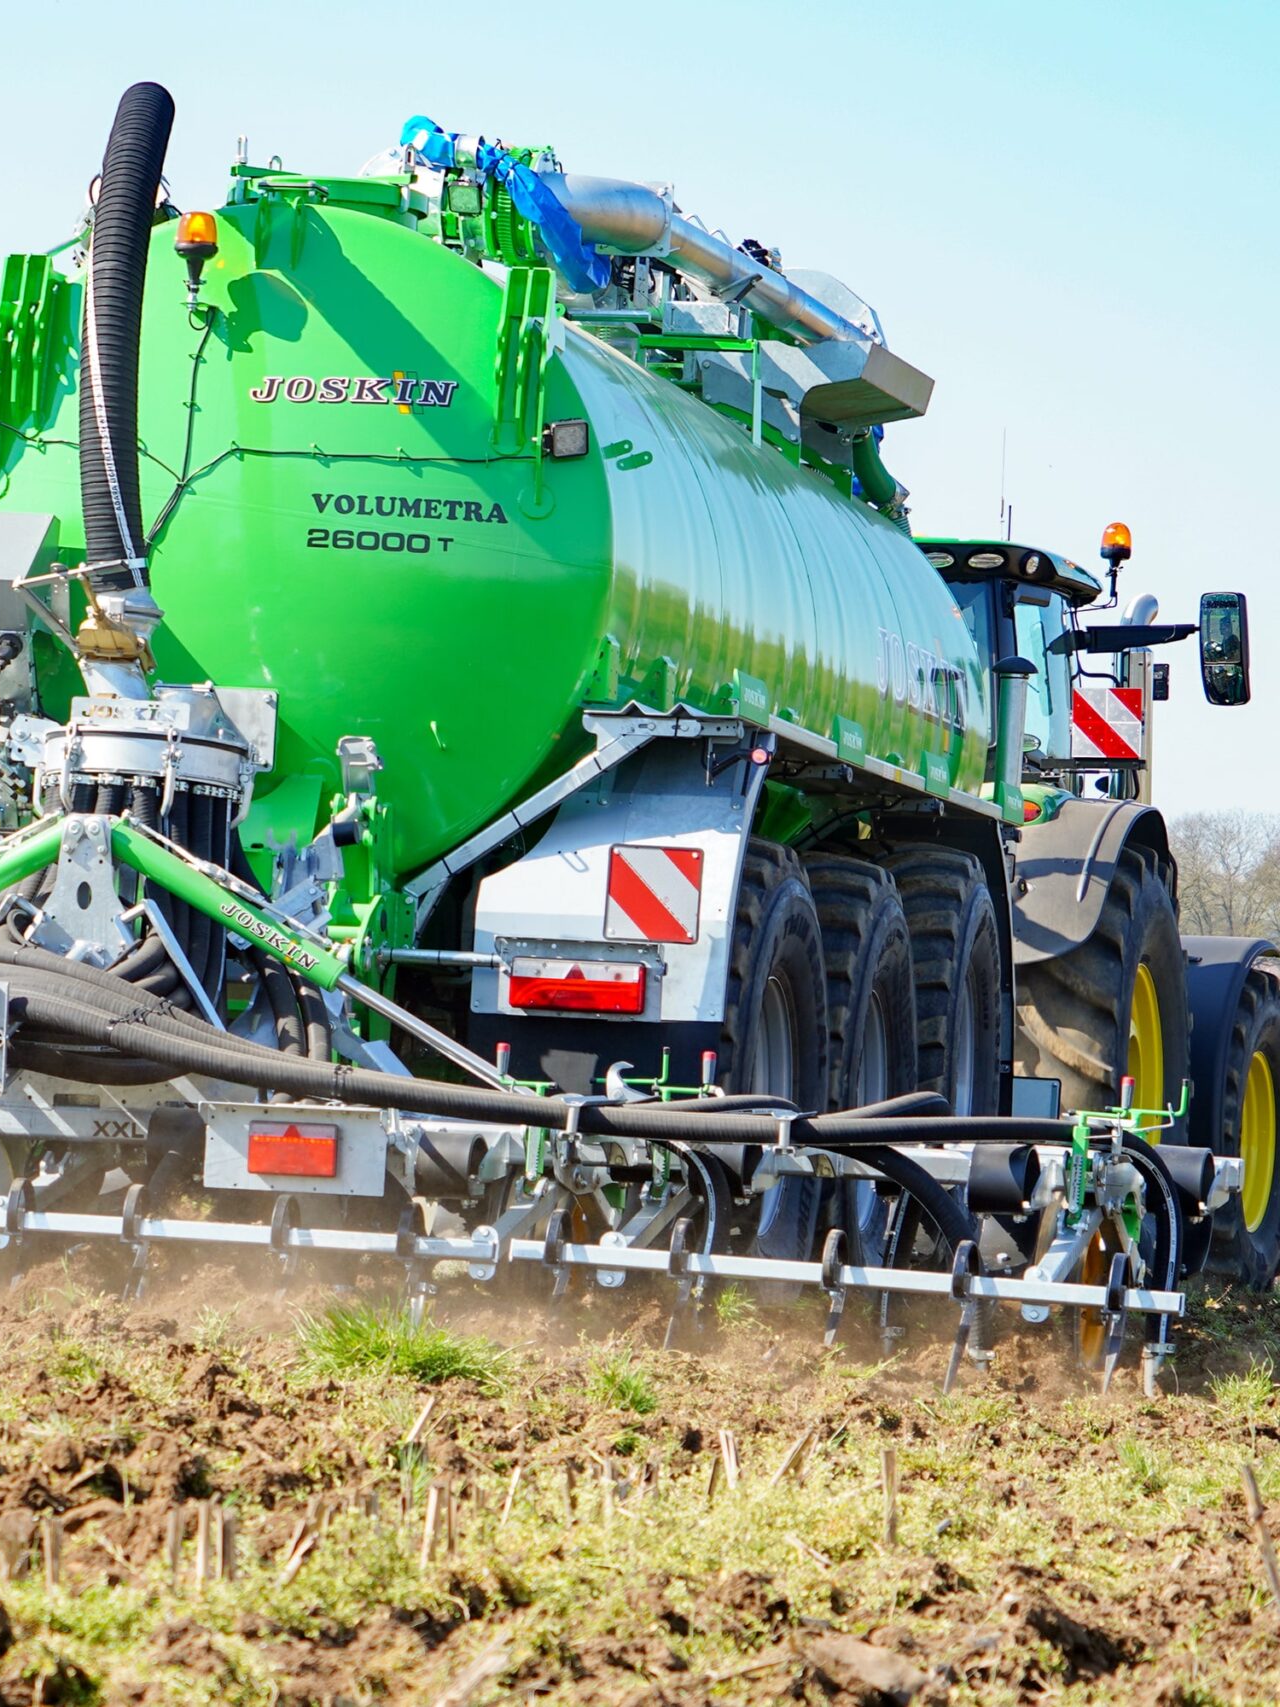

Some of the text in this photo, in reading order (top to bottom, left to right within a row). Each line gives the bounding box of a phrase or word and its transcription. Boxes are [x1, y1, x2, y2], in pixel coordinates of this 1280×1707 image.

[249, 376, 458, 407] JOSKIN
[311, 493, 509, 524] VOLUMETRA
[306, 528, 455, 553] 26000 T
[876, 625, 969, 738] JOSKIN
[220, 902, 319, 972] JOSKIN
[92, 1120, 145, 1139] XXL
